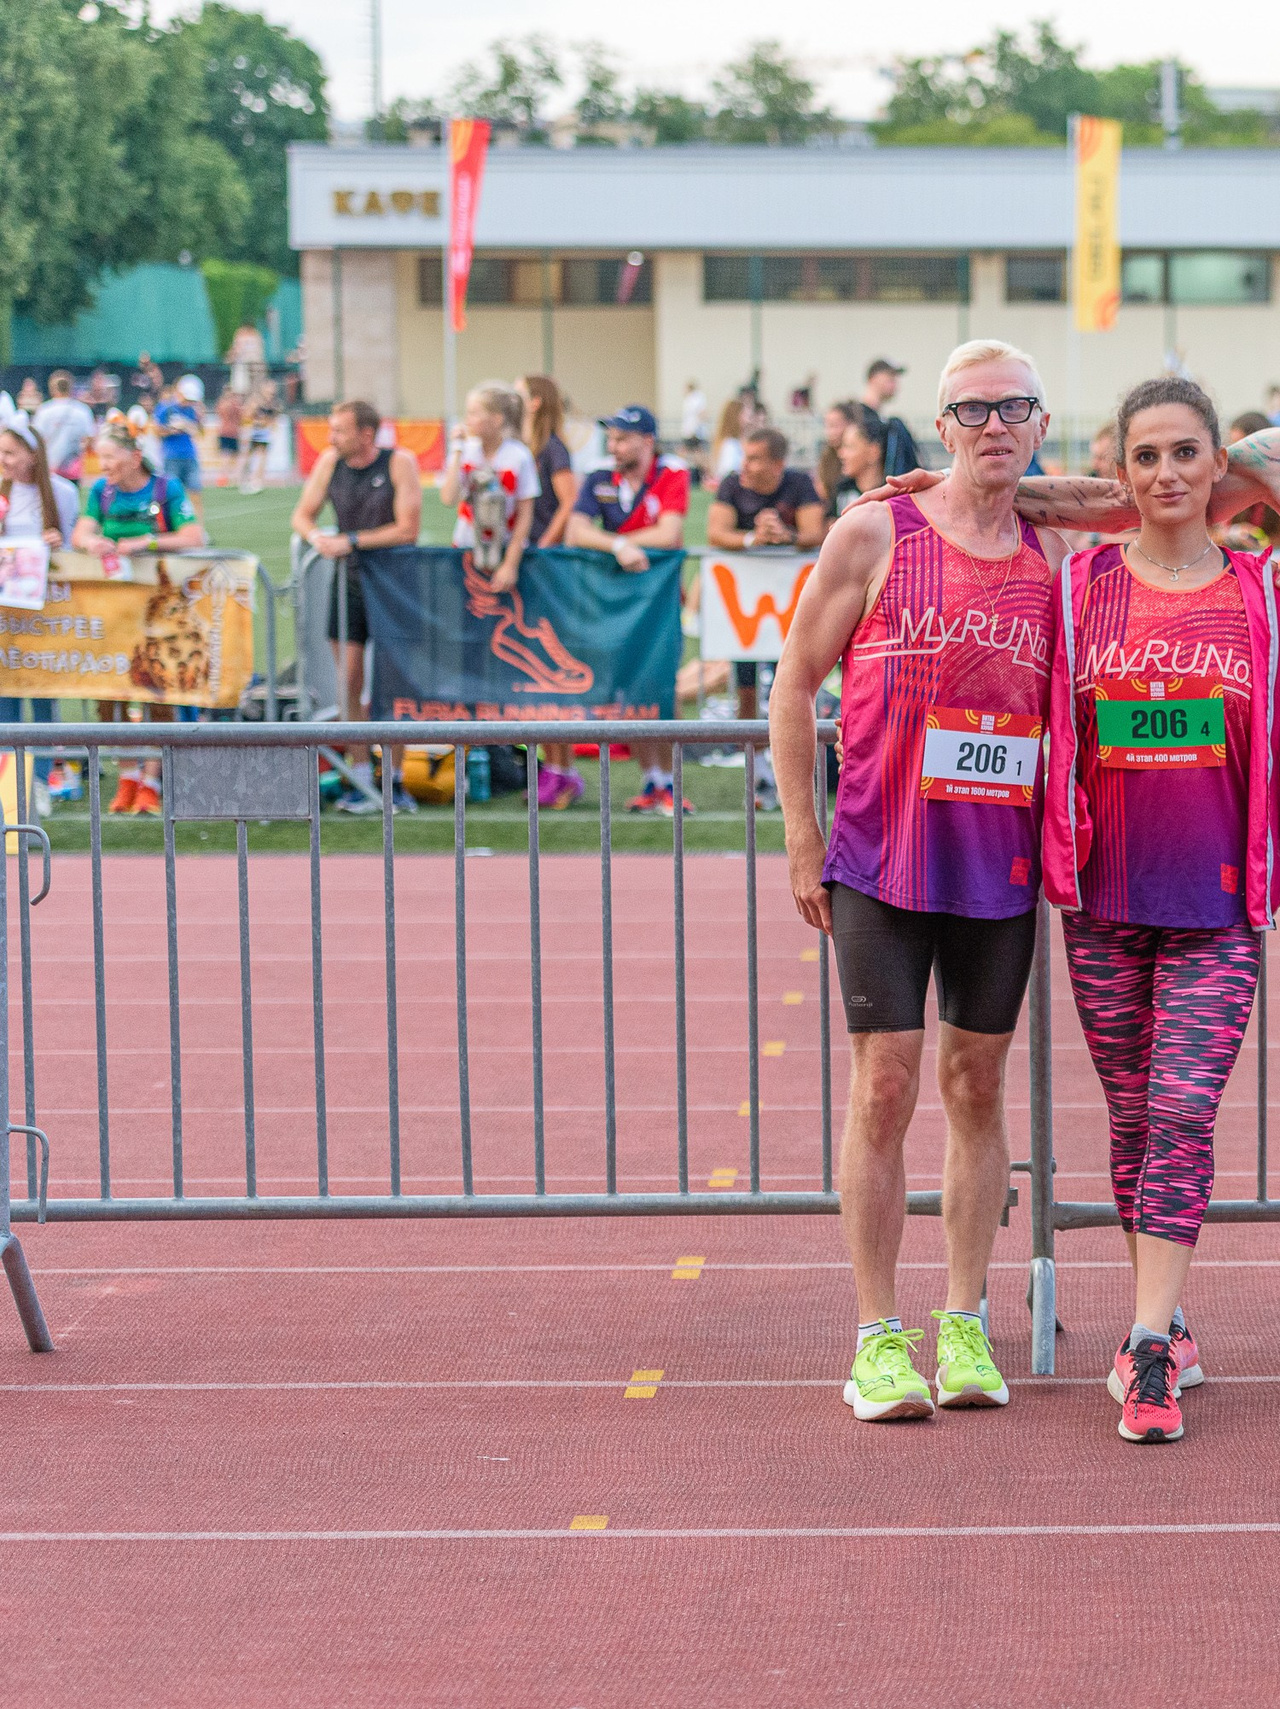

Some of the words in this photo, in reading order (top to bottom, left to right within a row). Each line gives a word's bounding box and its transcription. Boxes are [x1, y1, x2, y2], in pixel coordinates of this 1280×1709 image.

[332, 189, 440, 217] КАФЕ
[46, 581, 72, 602] Ы
[1131, 708, 1188, 739] 206
[1200, 720, 1211, 737] 4
[956, 741, 1008, 775] 206
[1016, 760, 1023, 776] 1
[1126, 753, 1135, 763] 4й
[1154, 753, 1168, 763] 400
[1169, 753, 1198, 763] метров
[986, 788, 1010, 798] метров
